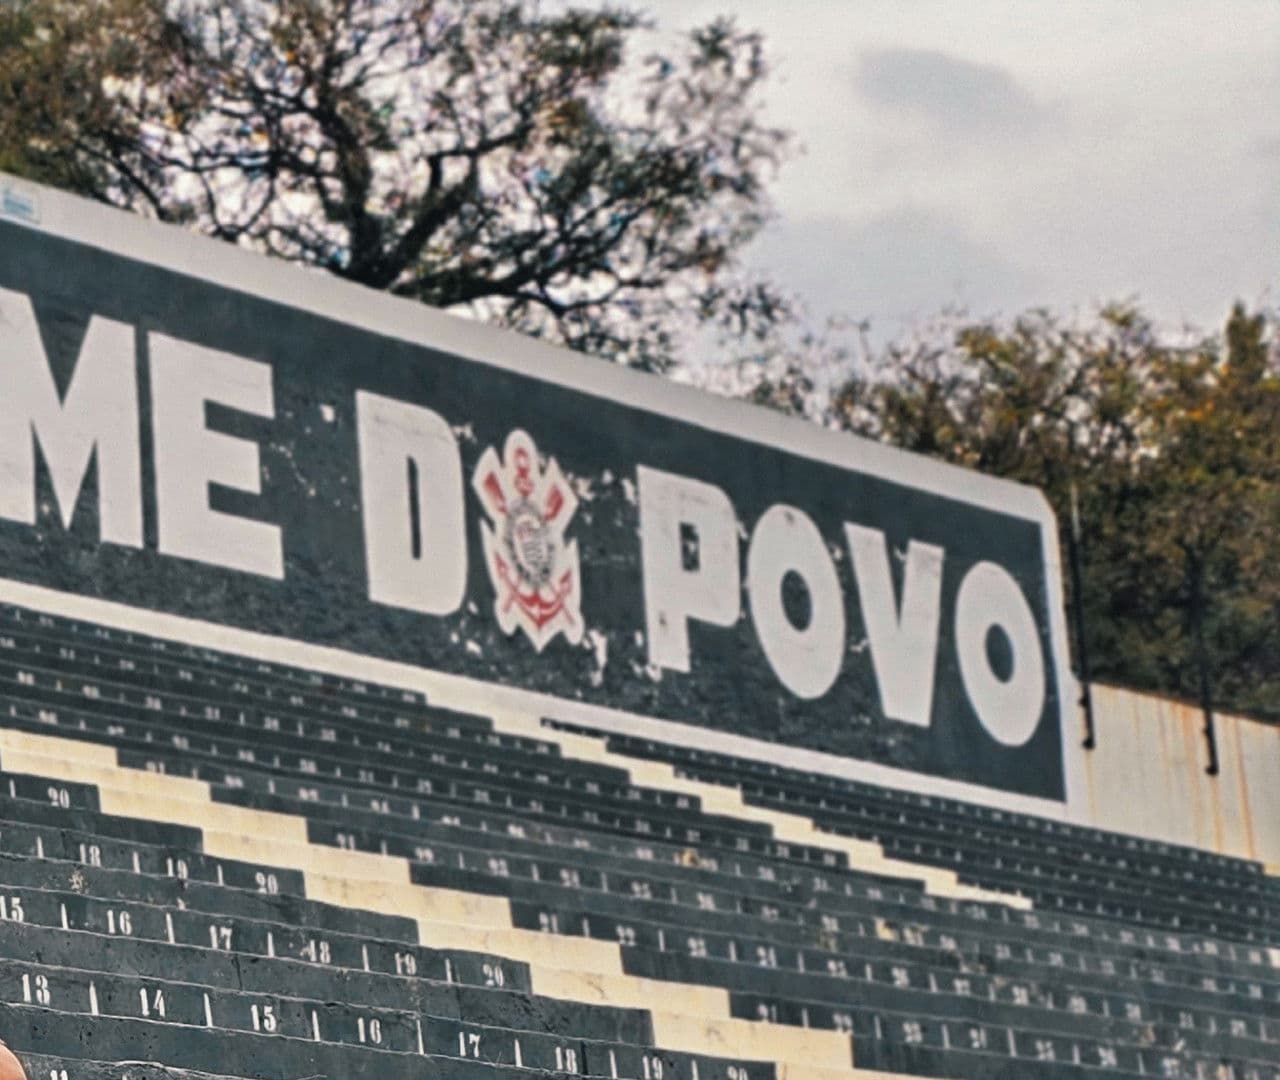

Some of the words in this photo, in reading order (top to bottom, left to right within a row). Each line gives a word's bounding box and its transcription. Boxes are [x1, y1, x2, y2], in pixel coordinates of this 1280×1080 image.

[639, 466, 1044, 748] POVO
[0, 896, 27, 925] 15
[108, 910, 131, 934] 16
[23, 974, 50, 1004] 13
[140, 989, 165, 1016] 14
[251, 1005, 276, 1031] 15
[358, 1018, 381, 1043] 16
